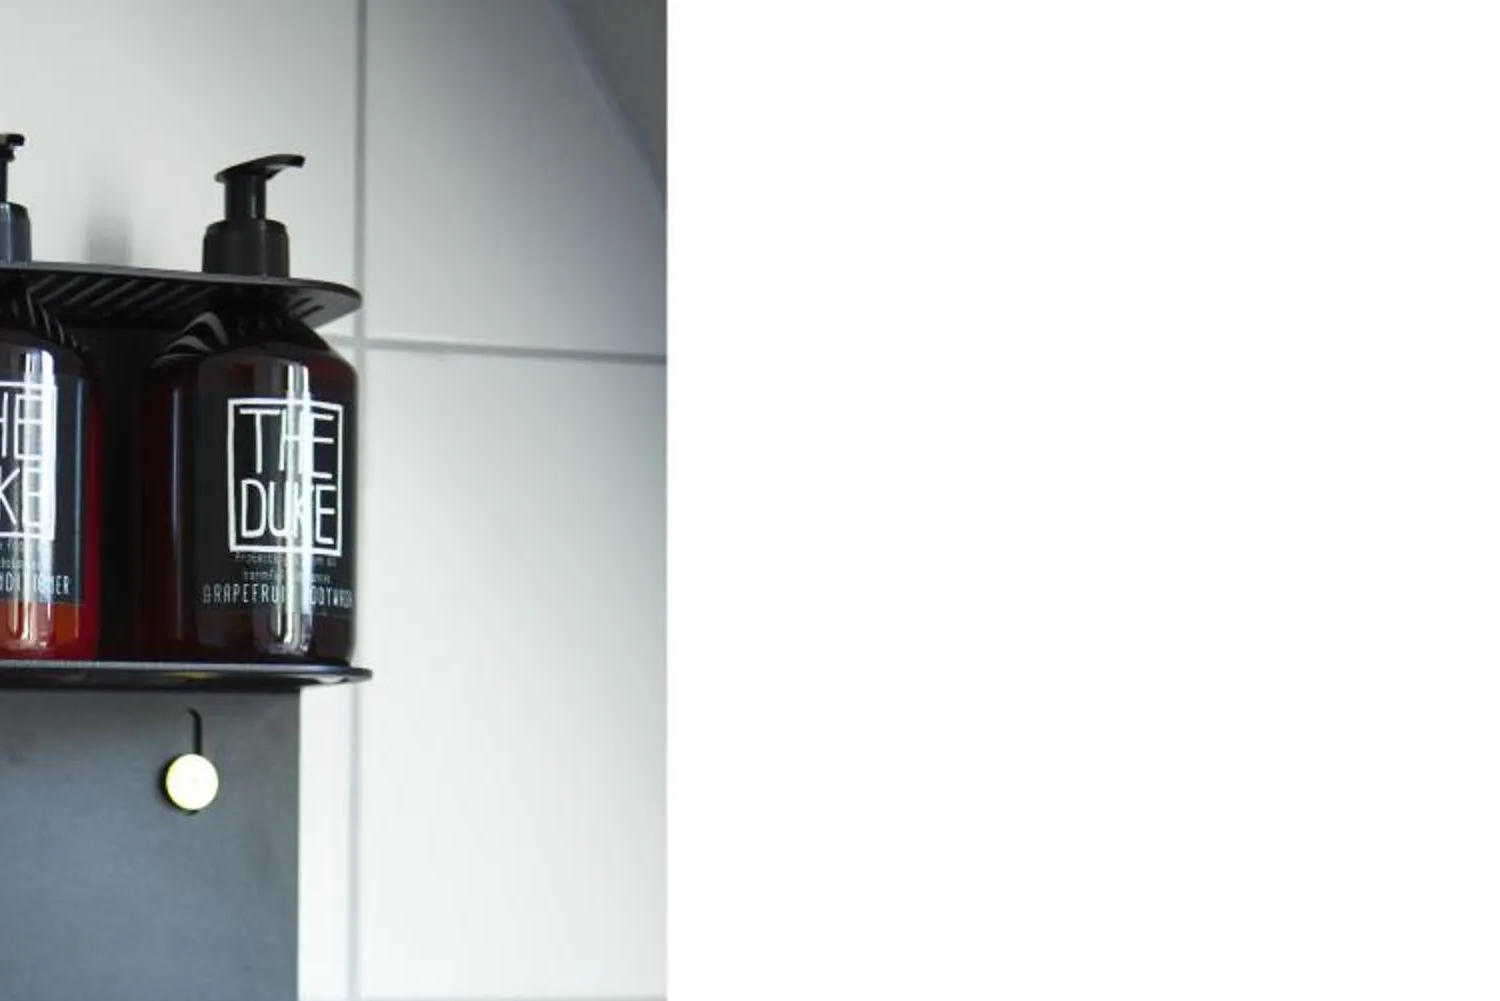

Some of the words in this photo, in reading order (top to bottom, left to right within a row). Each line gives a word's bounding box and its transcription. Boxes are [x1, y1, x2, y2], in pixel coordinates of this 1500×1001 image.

[239, 408, 335, 479] THE
[241, 479, 336, 545] DUKE
[203, 584, 294, 606] GRAPEFRUI
[300, 586, 354, 609] ODYWASH
